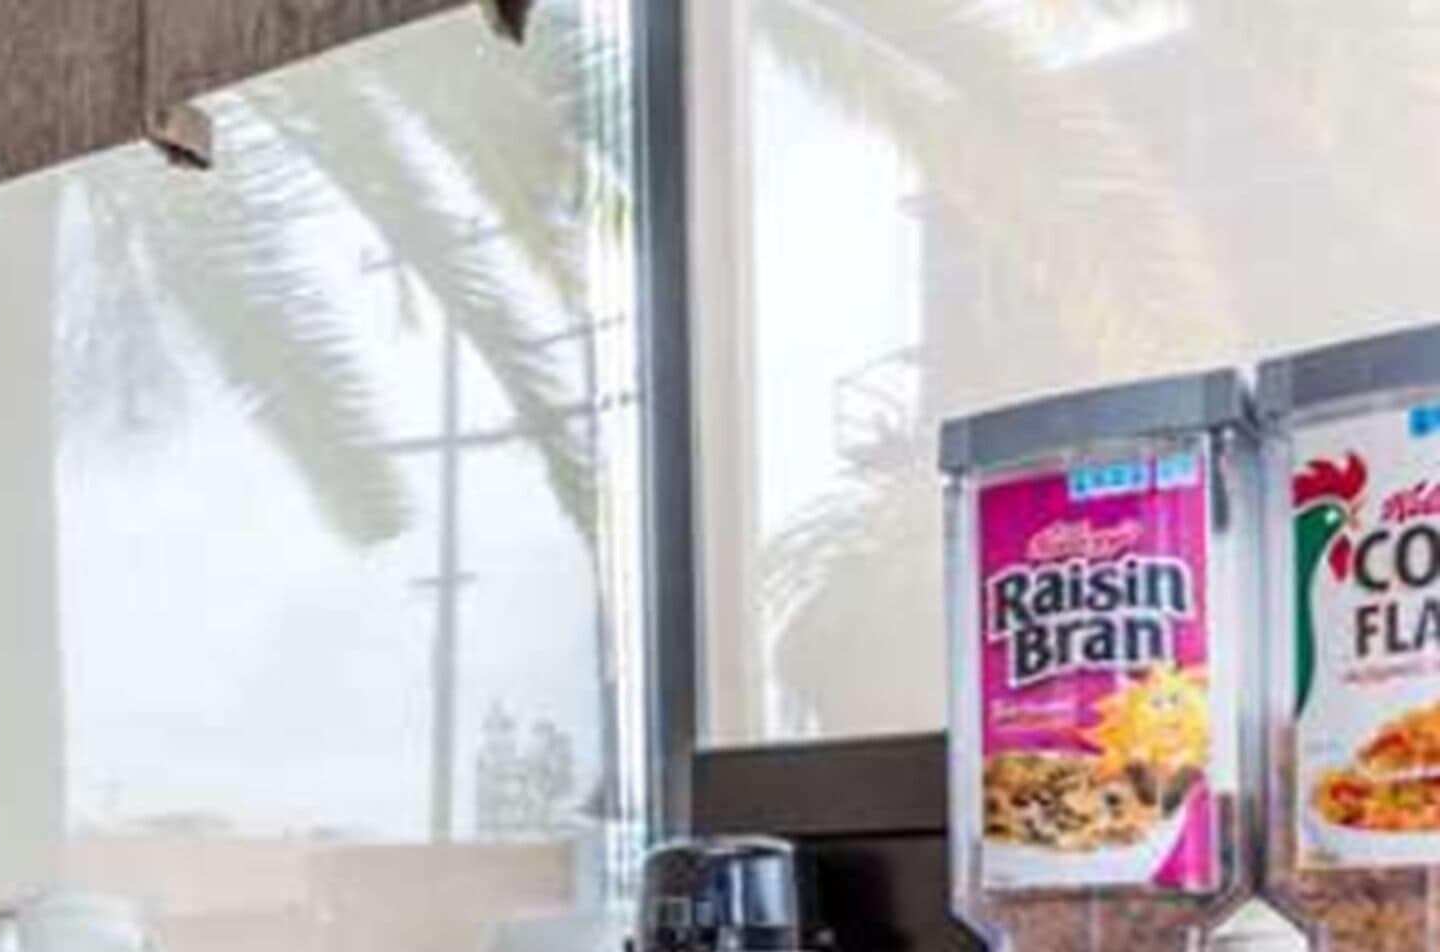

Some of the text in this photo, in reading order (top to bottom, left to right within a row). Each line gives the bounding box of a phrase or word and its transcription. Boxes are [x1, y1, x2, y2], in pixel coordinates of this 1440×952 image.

[1355, 524, 1440, 591] CO
[989, 557, 1189, 635] Raisin
[1012, 613, 1161, 682] Bran
